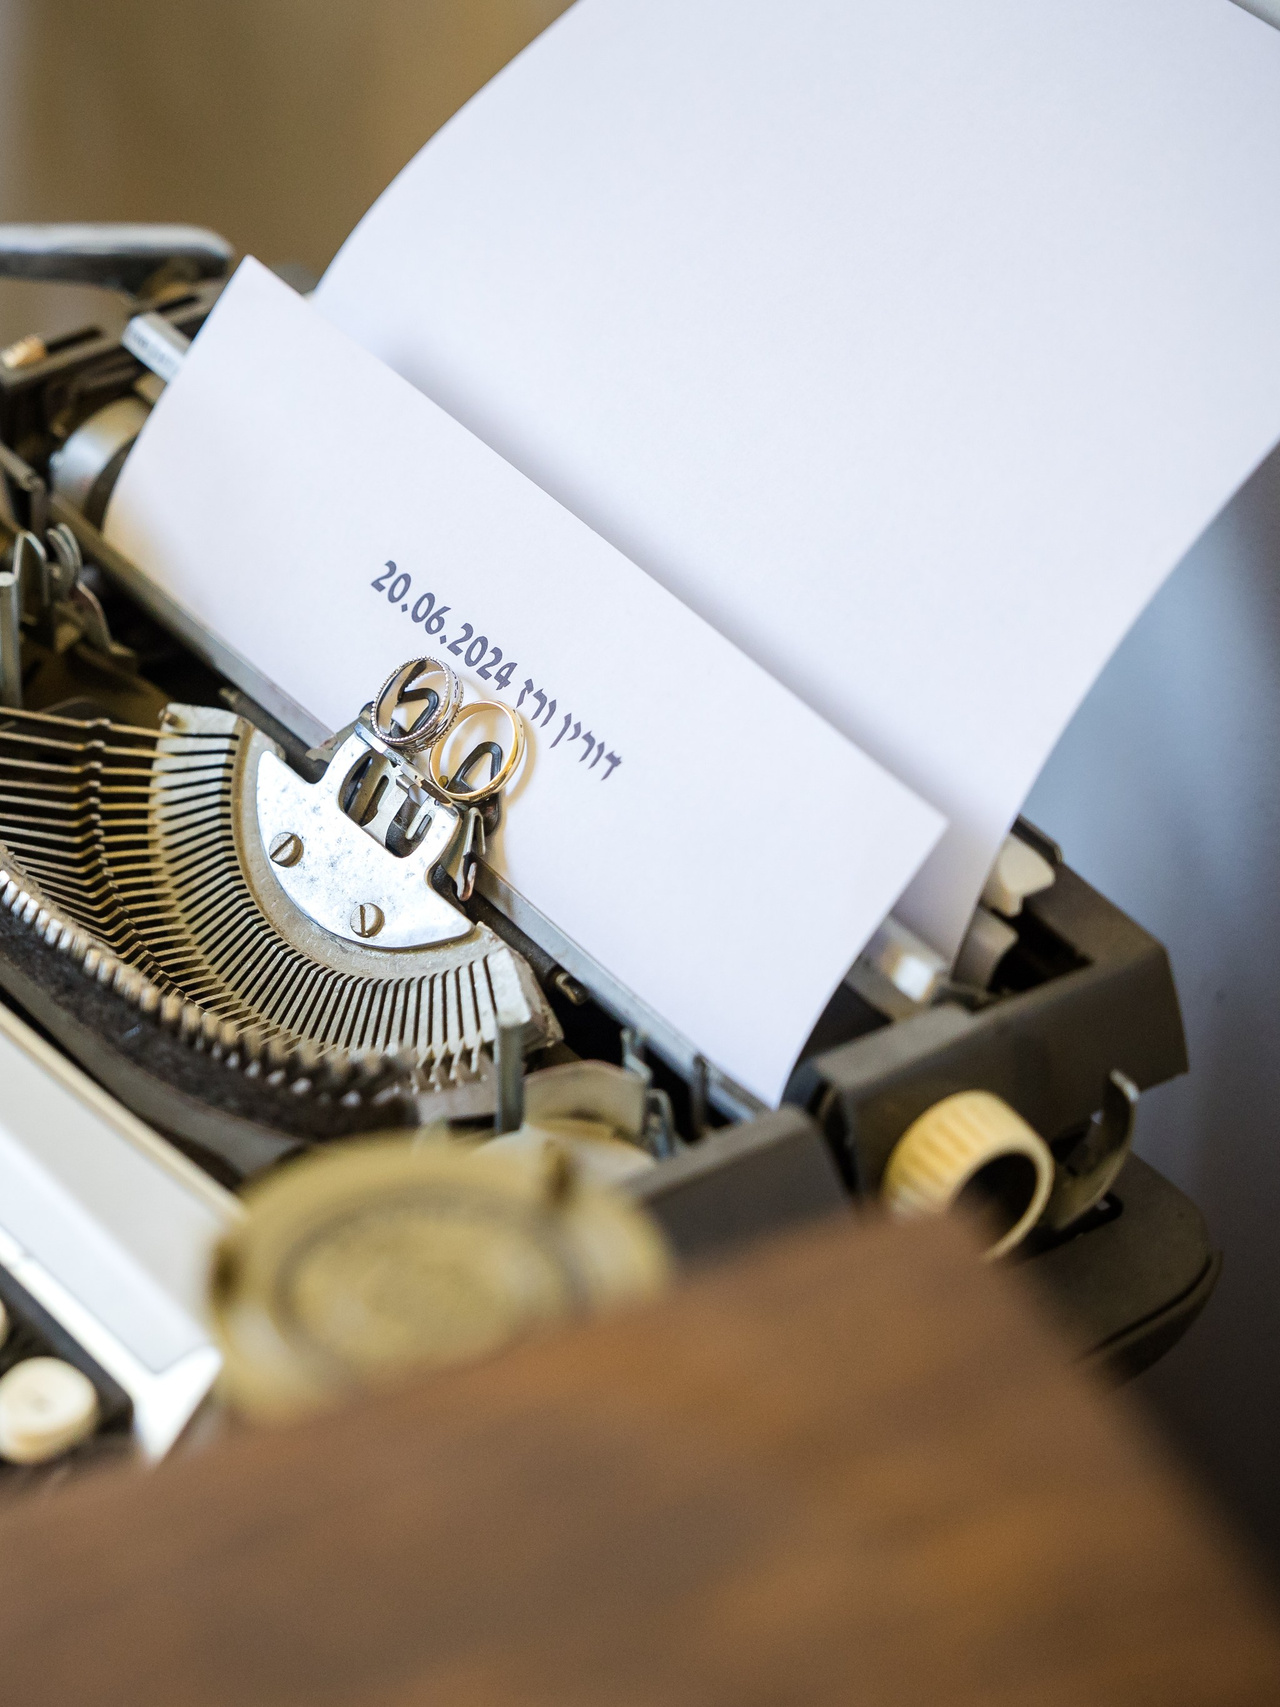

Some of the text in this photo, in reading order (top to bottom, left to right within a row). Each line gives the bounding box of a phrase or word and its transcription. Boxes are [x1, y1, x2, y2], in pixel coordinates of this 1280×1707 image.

[370, 560, 518, 691] 20.06.2024
[516, 678, 557, 728] ורז
[549, 713, 622, 781] דורין
